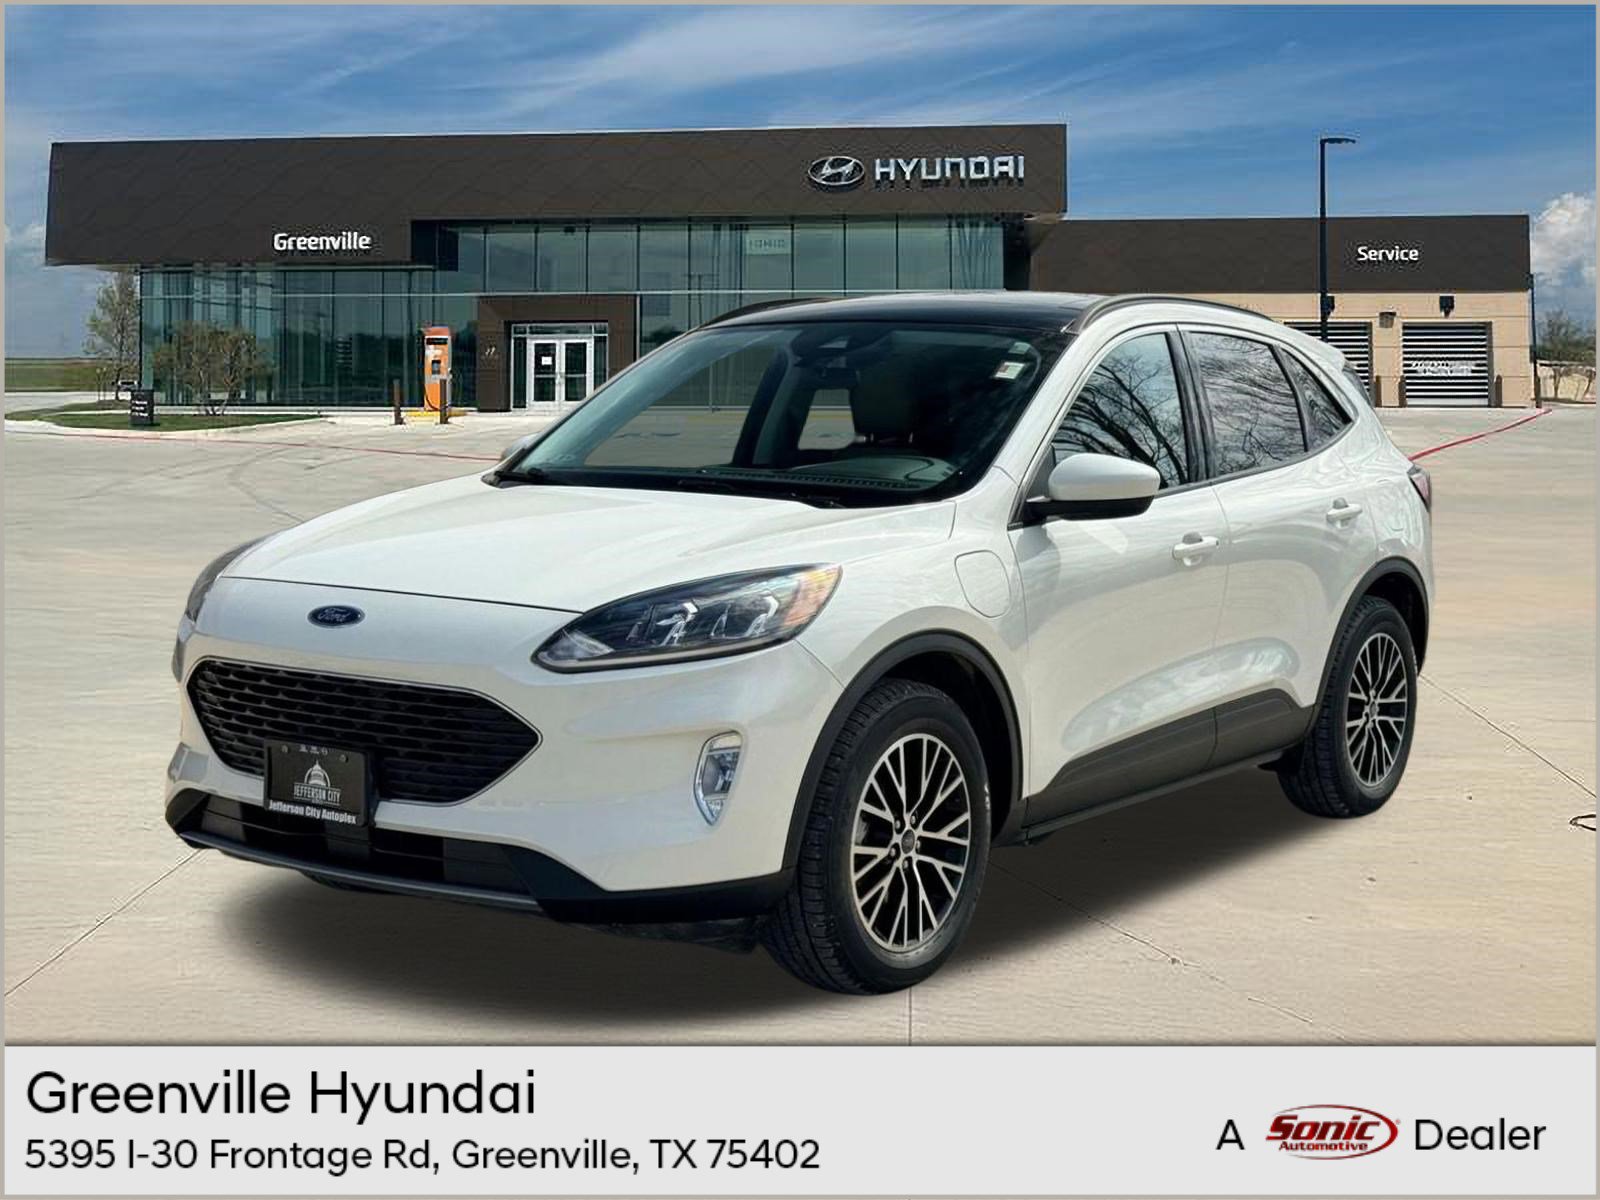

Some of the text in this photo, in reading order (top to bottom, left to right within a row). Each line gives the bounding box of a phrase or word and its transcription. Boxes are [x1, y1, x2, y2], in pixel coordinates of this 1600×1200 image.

[874, 155, 1025, 181] HYUNDAI
[273, 231, 371, 251] Greenville
[1357, 245, 1420, 262] Service
[327, 790, 341, 804] CITY
[269, 800, 356, 824] Jefferson City Autoplex
